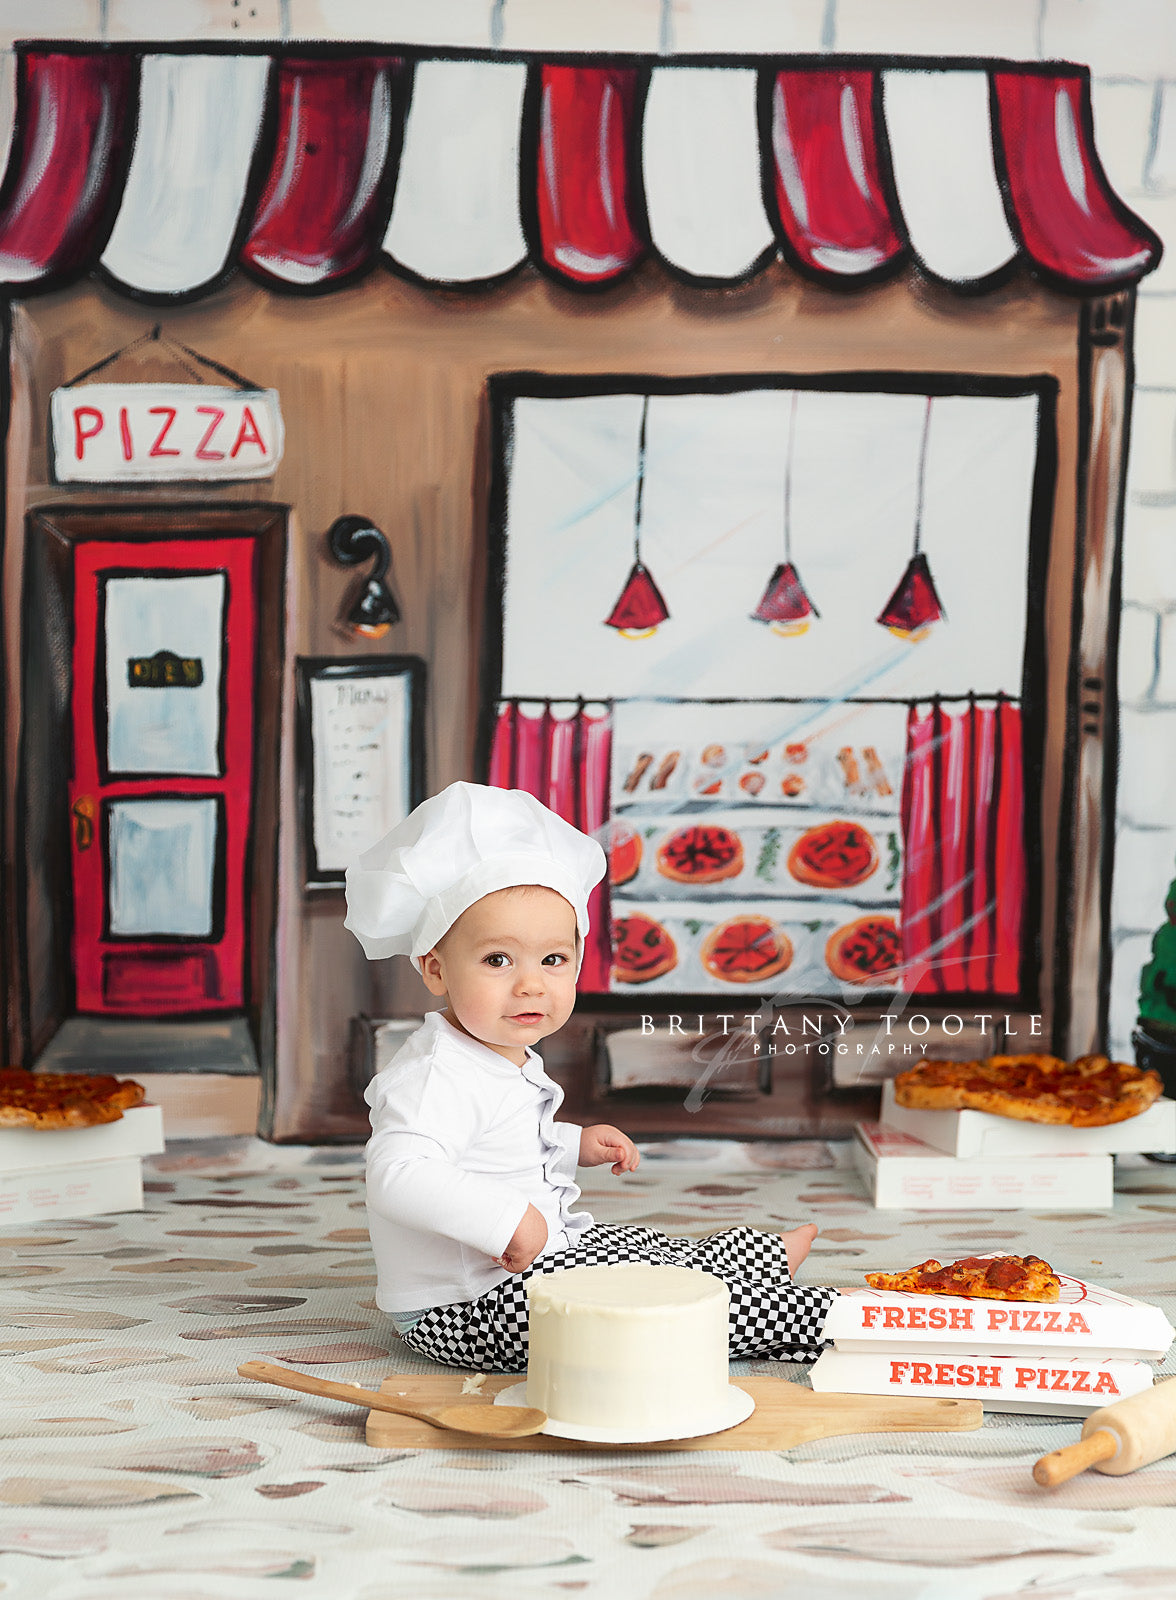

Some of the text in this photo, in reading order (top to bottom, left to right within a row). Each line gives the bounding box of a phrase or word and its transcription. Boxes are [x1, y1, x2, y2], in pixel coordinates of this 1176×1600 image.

[73, 405, 267, 461] PIZZA
[861, 1305, 1093, 1335] FRESH PIZZA
[888, 1360, 1121, 1396] FRESH PIZZA
